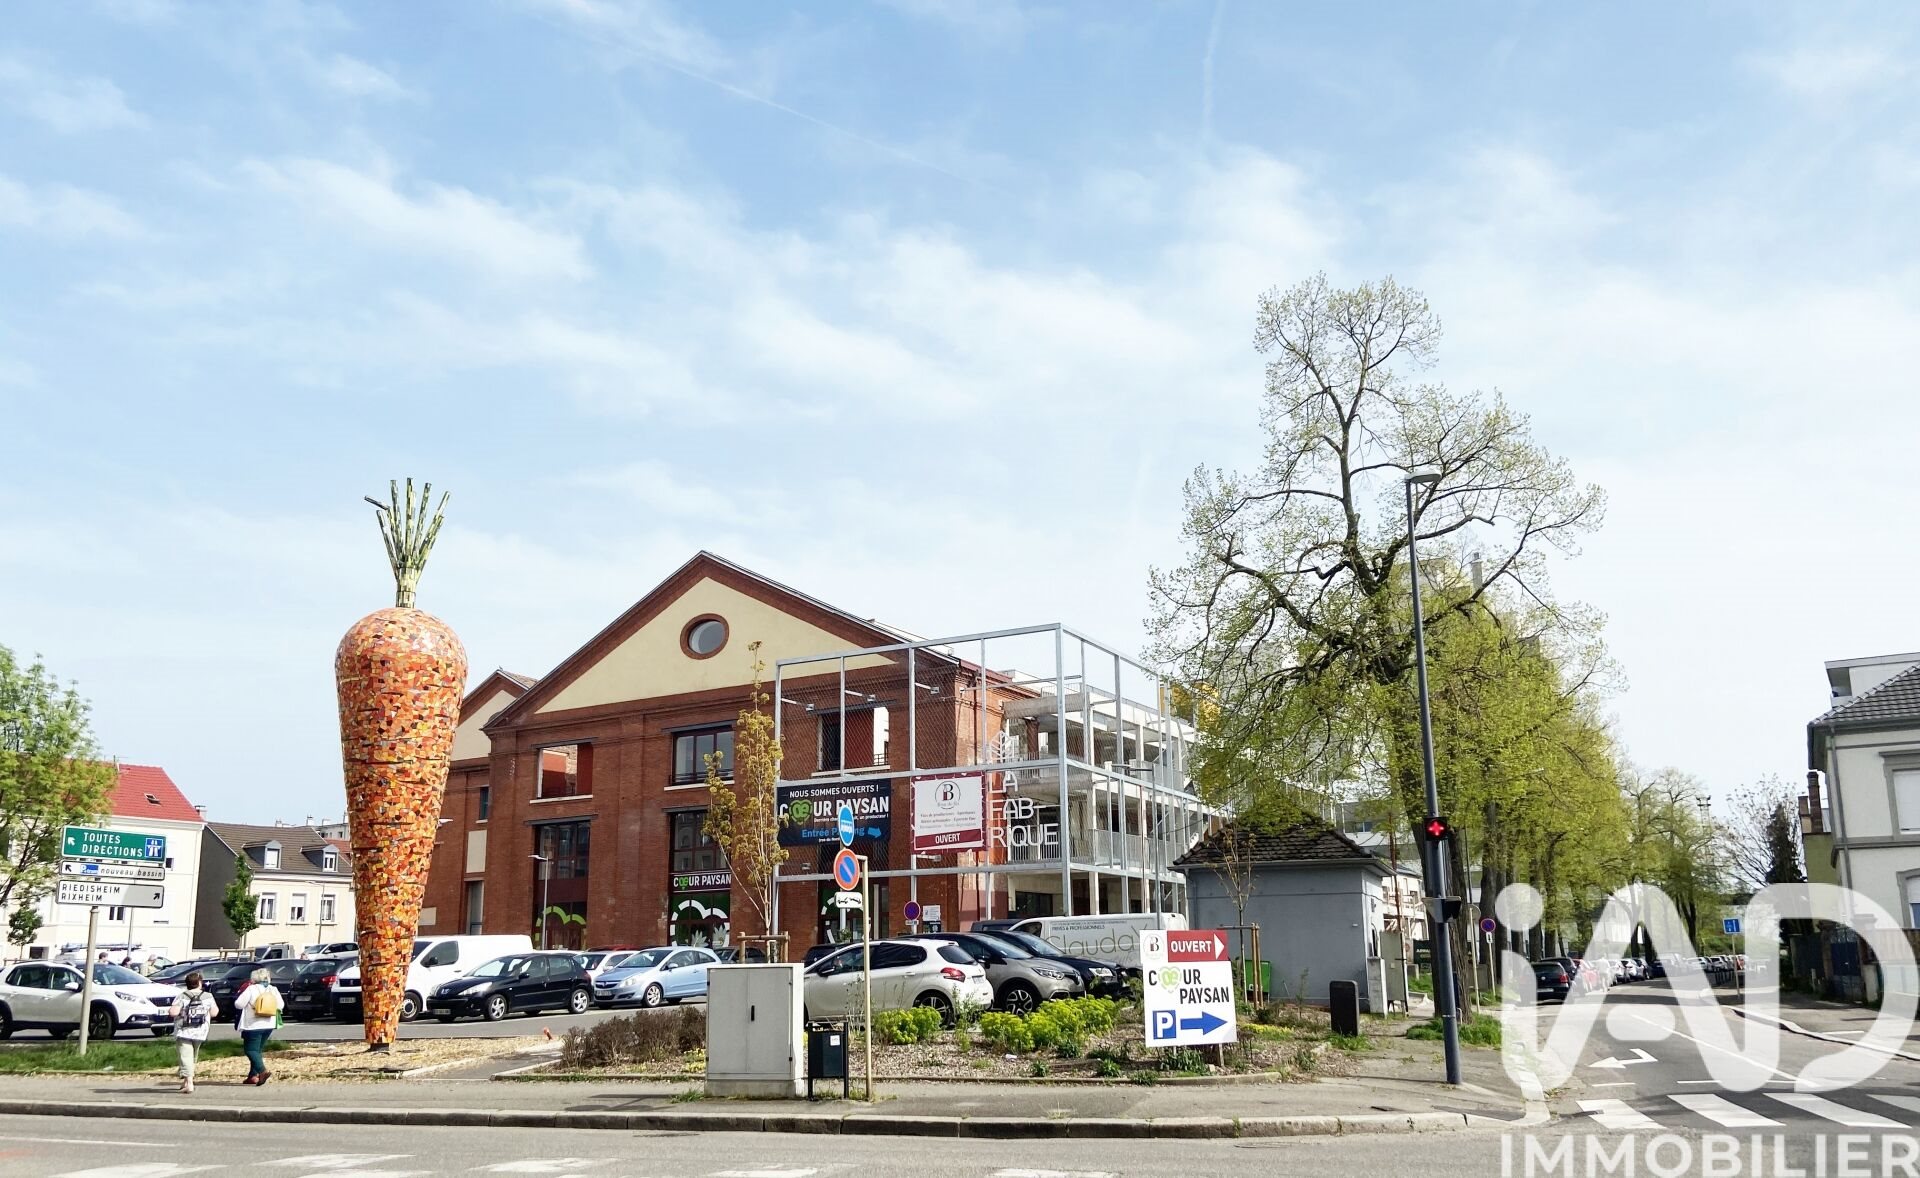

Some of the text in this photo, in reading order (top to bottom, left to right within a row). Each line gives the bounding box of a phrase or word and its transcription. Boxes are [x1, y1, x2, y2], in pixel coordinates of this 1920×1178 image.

[989, 771, 1018, 793] LA
[789, 790, 809, 798] NOUS
[810, 787, 840, 797] SOMMES
[841, 785, 875, 794] OUVERTS
[83, 832, 121, 844] TOUTES
[801, 827, 829, 838] Entrée
[935, 833, 960, 844] OUVERT
[990, 823, 1059, 848] RIQUE
[82, 844, 143, 857] DIRECTIONS
[100, 868, 134, 876] nouveau
[702, 874, 732, 886] PAYSAN
[62, 883, 120, 894] RIEDISHEIM
[61, 893, 102, 902] RIXHEIM
[1170, 940, 1212, 953] OUVERT
[1180, 986, 1230, 1004] PAYSAN
[1156, 1011, 1174, 1038] P
